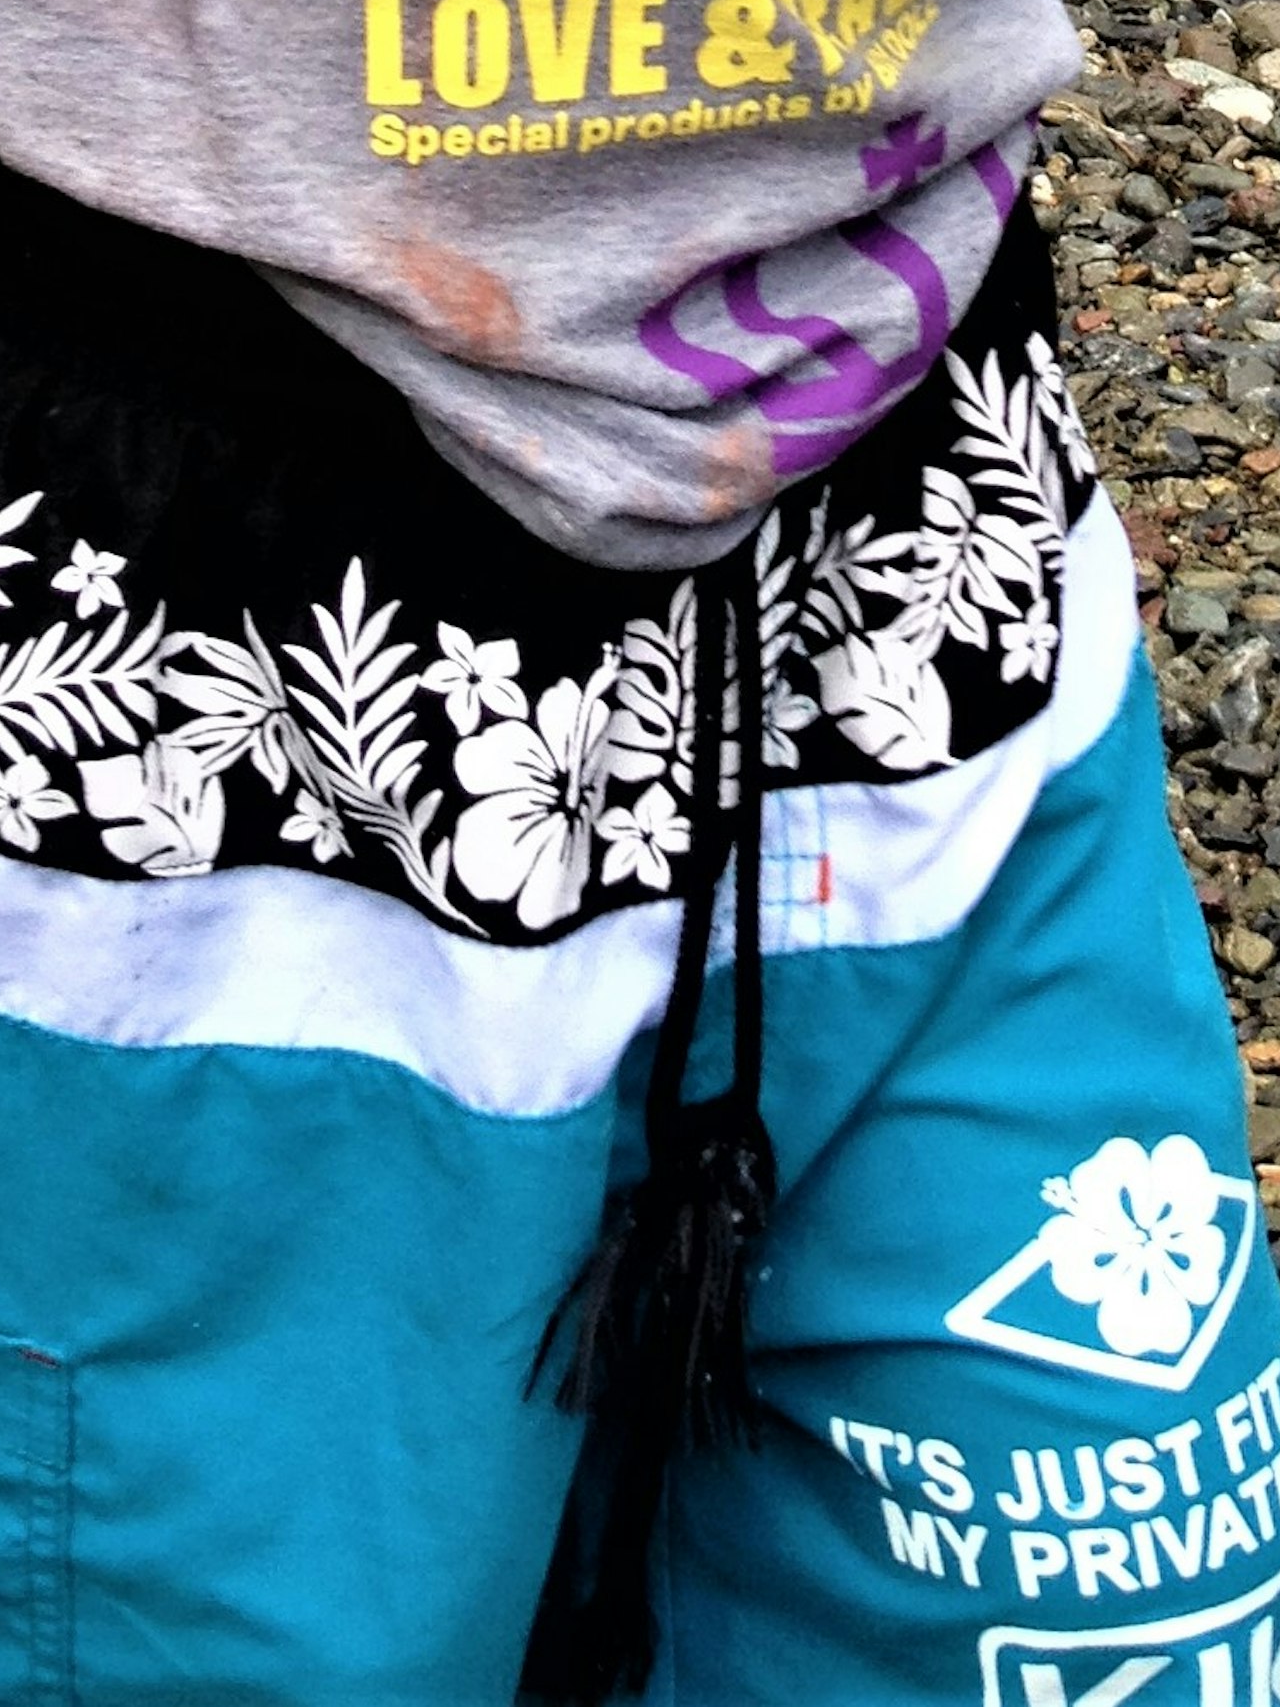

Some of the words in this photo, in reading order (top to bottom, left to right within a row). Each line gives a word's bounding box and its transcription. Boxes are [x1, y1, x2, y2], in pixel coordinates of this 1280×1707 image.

[369, 109, 570, 165] Special
[578, 92, 812, 154] products
[822, 72, 874, 114] by
[828, 1415, 975, 1513] IT'S
[995, 1418, 1203, 1522] JUST
[880, 1496, 989, 1589] MY
